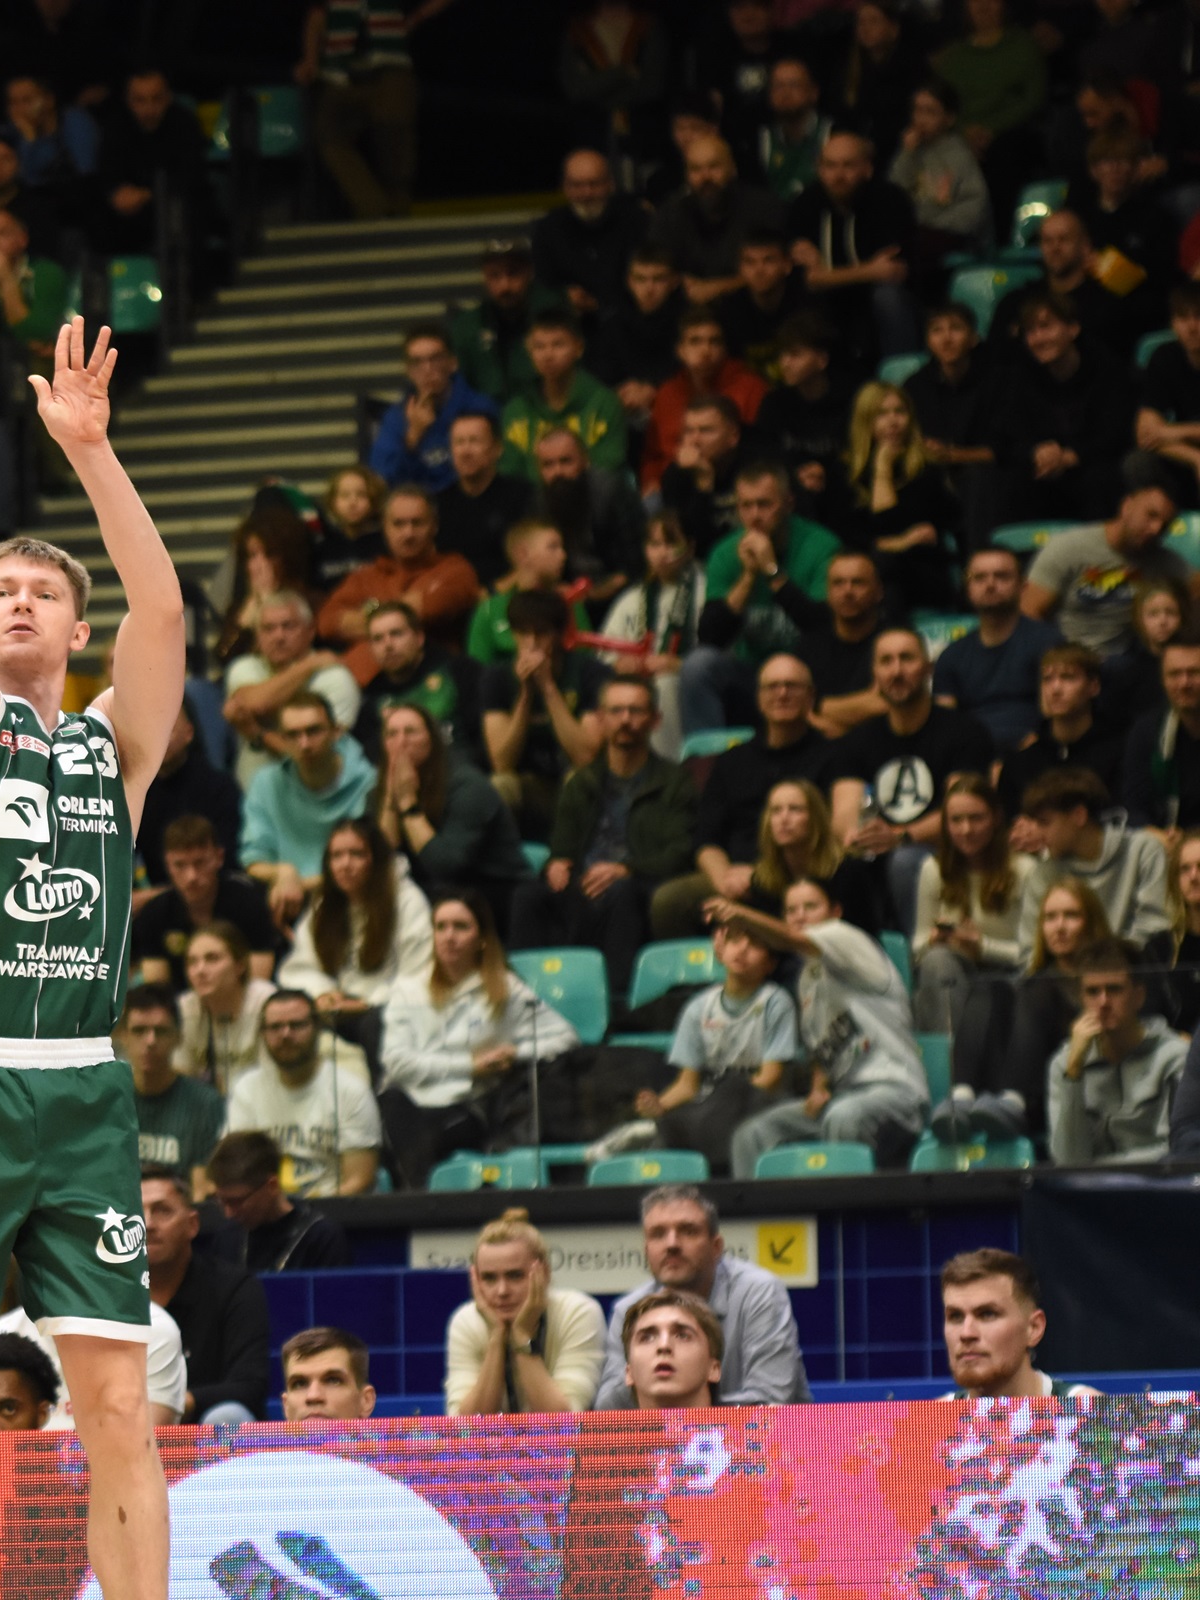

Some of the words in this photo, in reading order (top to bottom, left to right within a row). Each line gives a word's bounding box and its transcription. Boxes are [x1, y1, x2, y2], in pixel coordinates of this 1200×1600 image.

[52, 736, 119, 779] 23
[57, 795, 114, 816] ORLEN
[59, 816, 119, 835] TERMIKA
[25, 878, 84, 911] LOTTO
